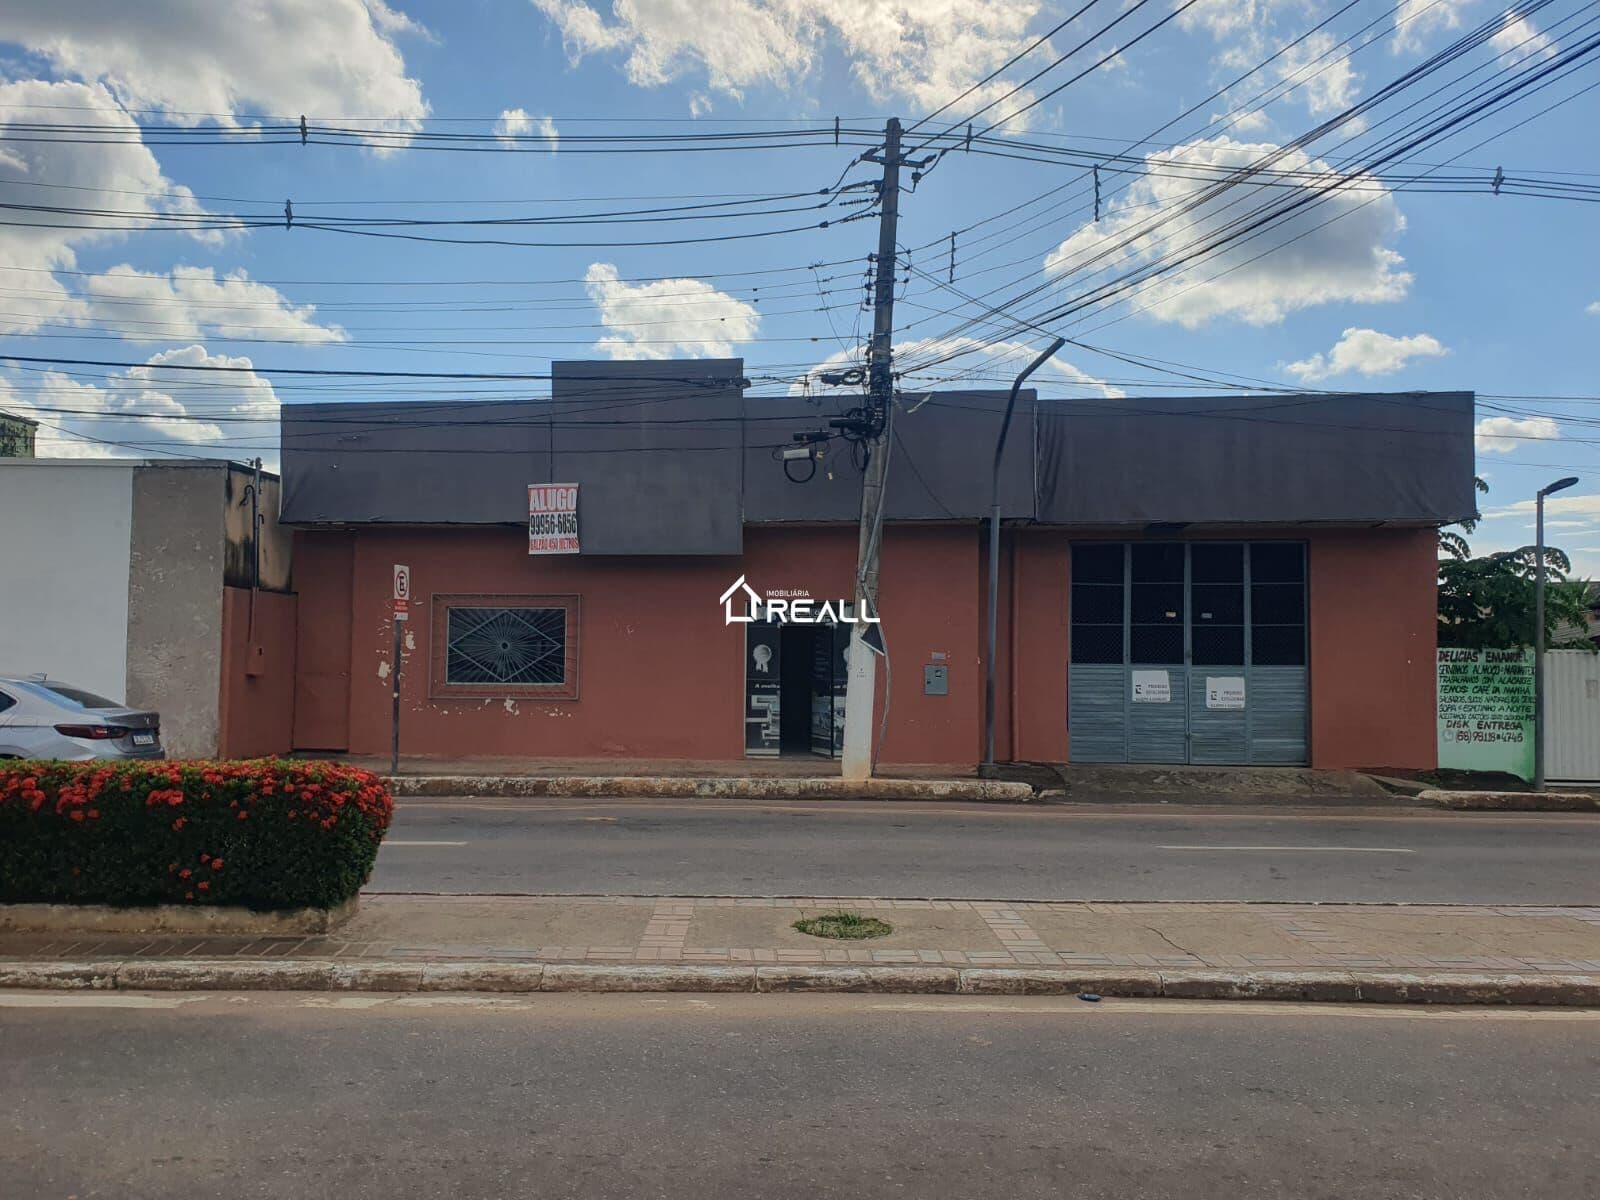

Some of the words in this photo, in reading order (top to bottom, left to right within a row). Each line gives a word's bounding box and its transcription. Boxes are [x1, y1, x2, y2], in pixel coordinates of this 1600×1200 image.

[530, 488, 577, 511] ALUGO
[1446, 720, 1470, 728] DISK
[1476, 721, 1524, 730] ENTREGA
